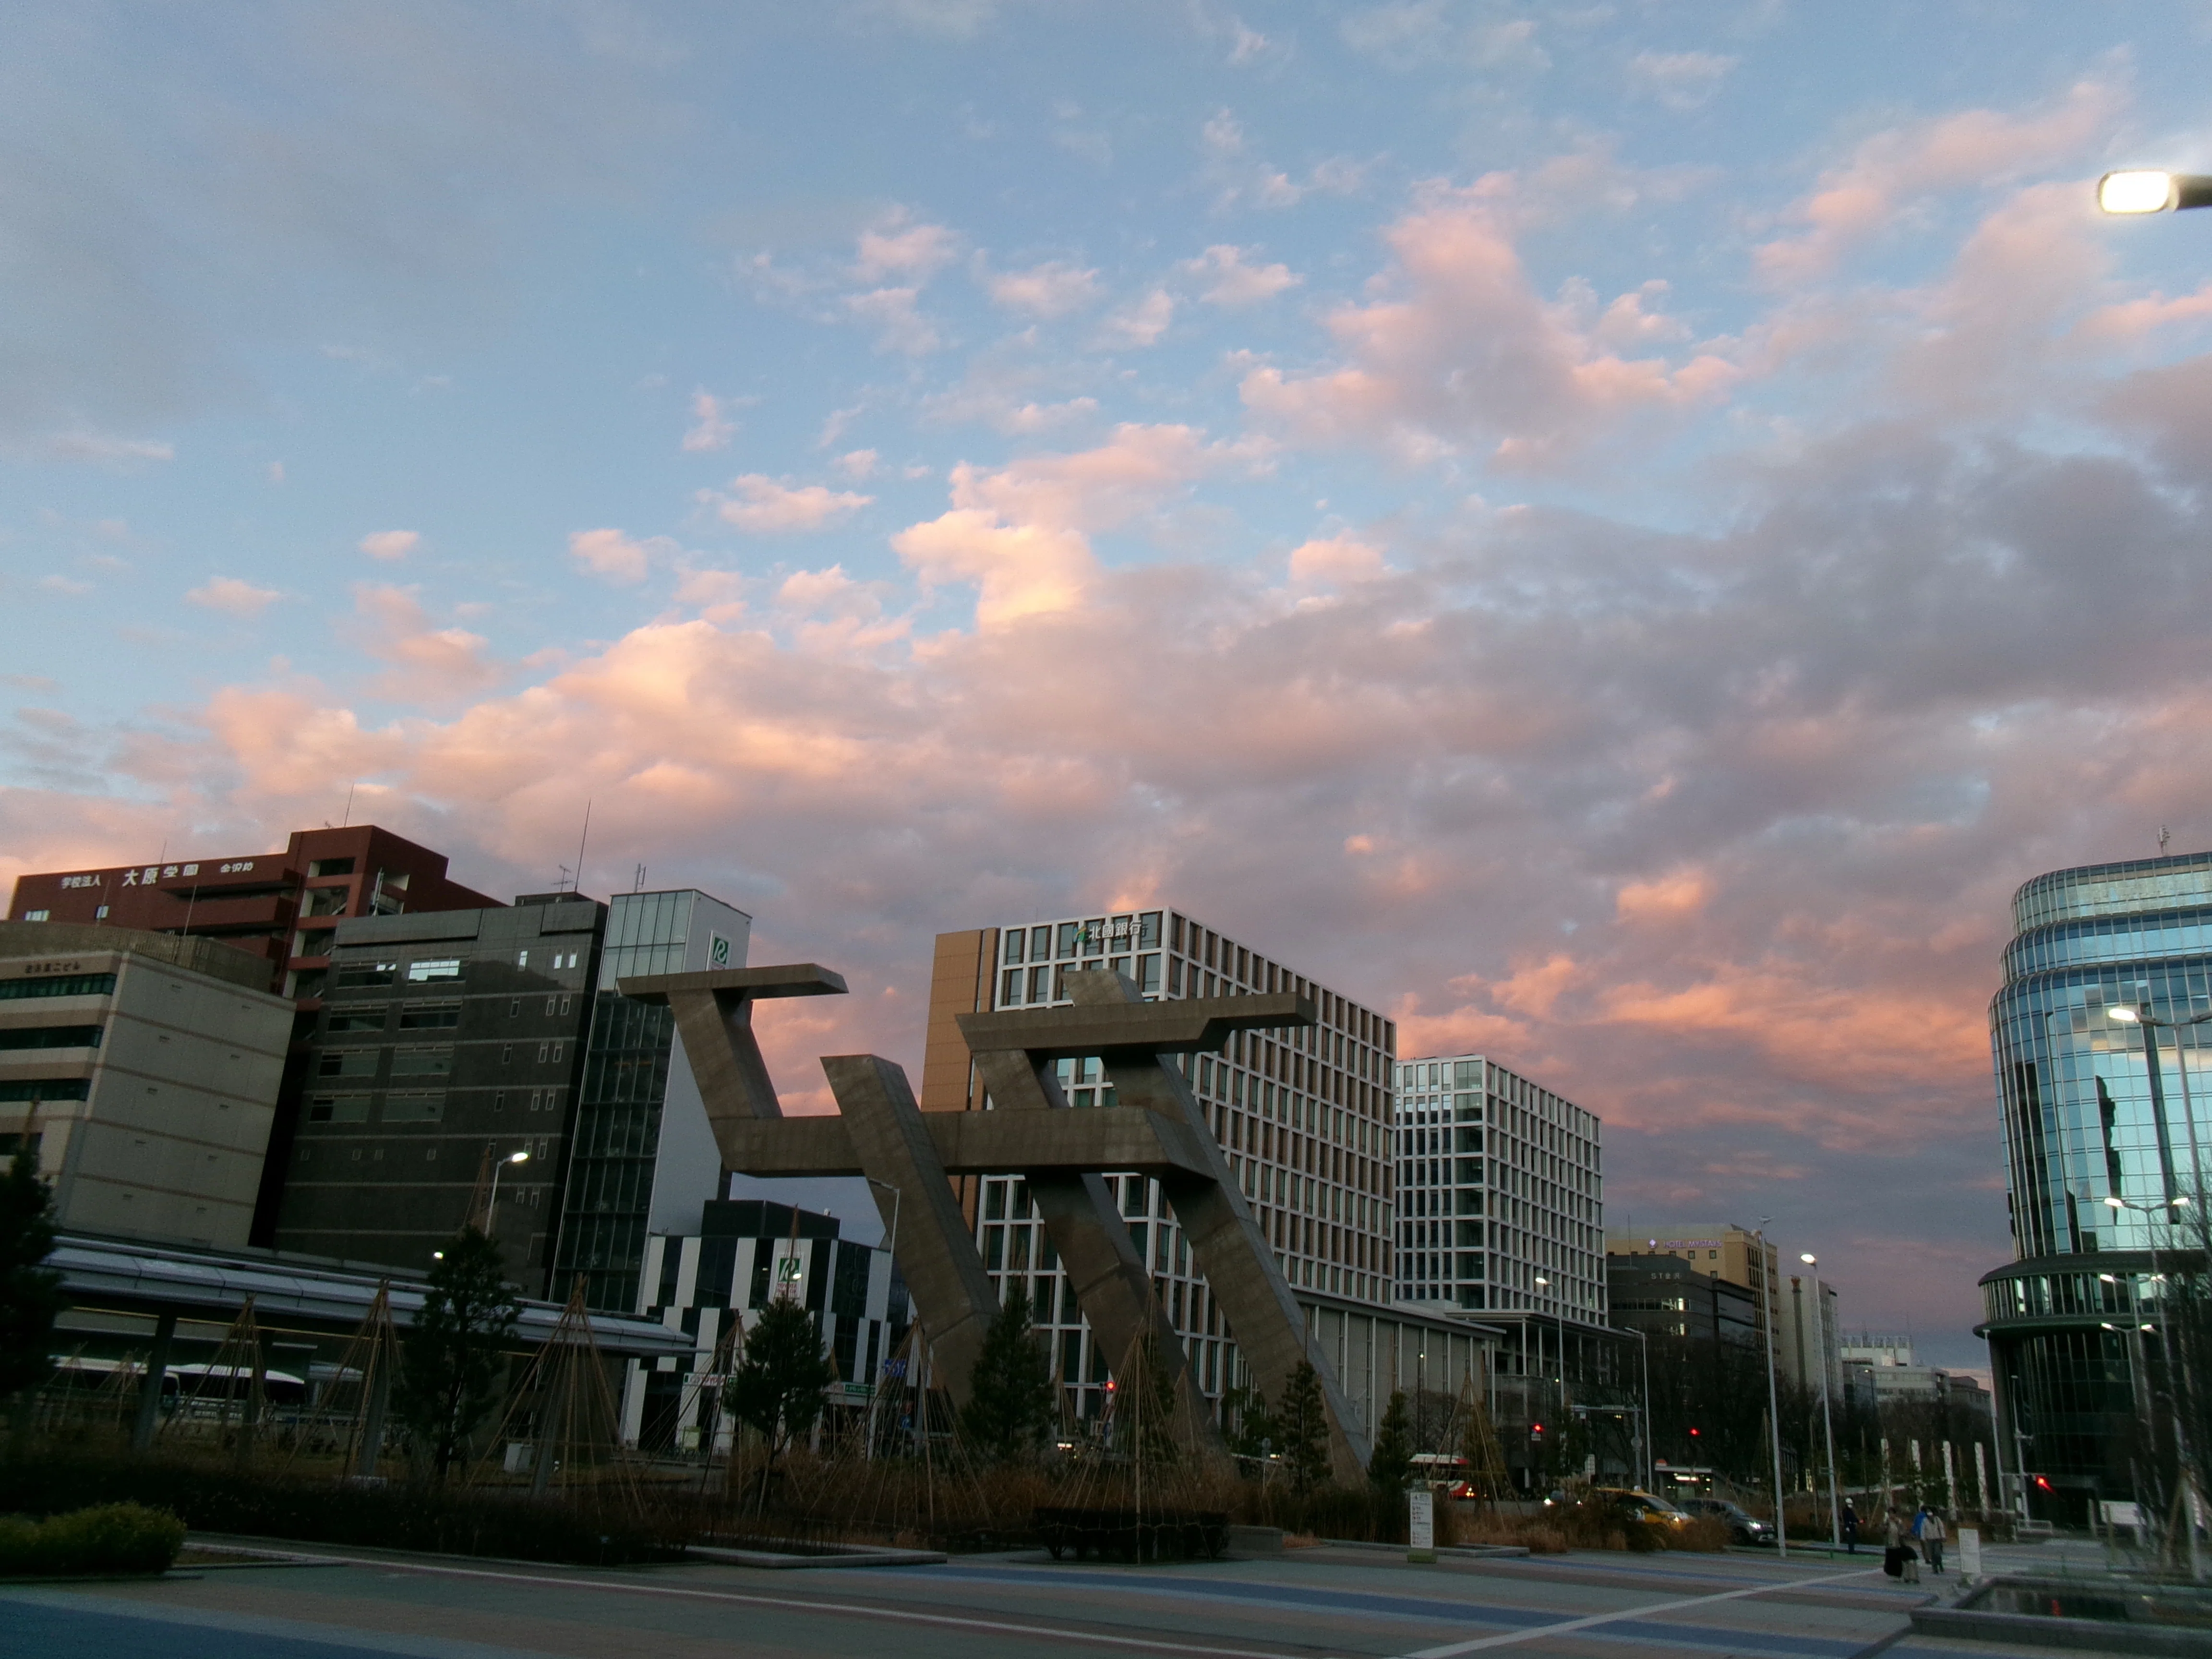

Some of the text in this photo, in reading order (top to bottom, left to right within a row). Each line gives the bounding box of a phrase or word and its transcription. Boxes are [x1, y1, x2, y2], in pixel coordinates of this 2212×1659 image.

[122, 864, 199, 887] 大原学園
[1089, 920, 1142, 939] 北國銀行
[1688, 1239, 1722, 1248] MYSTAYS
